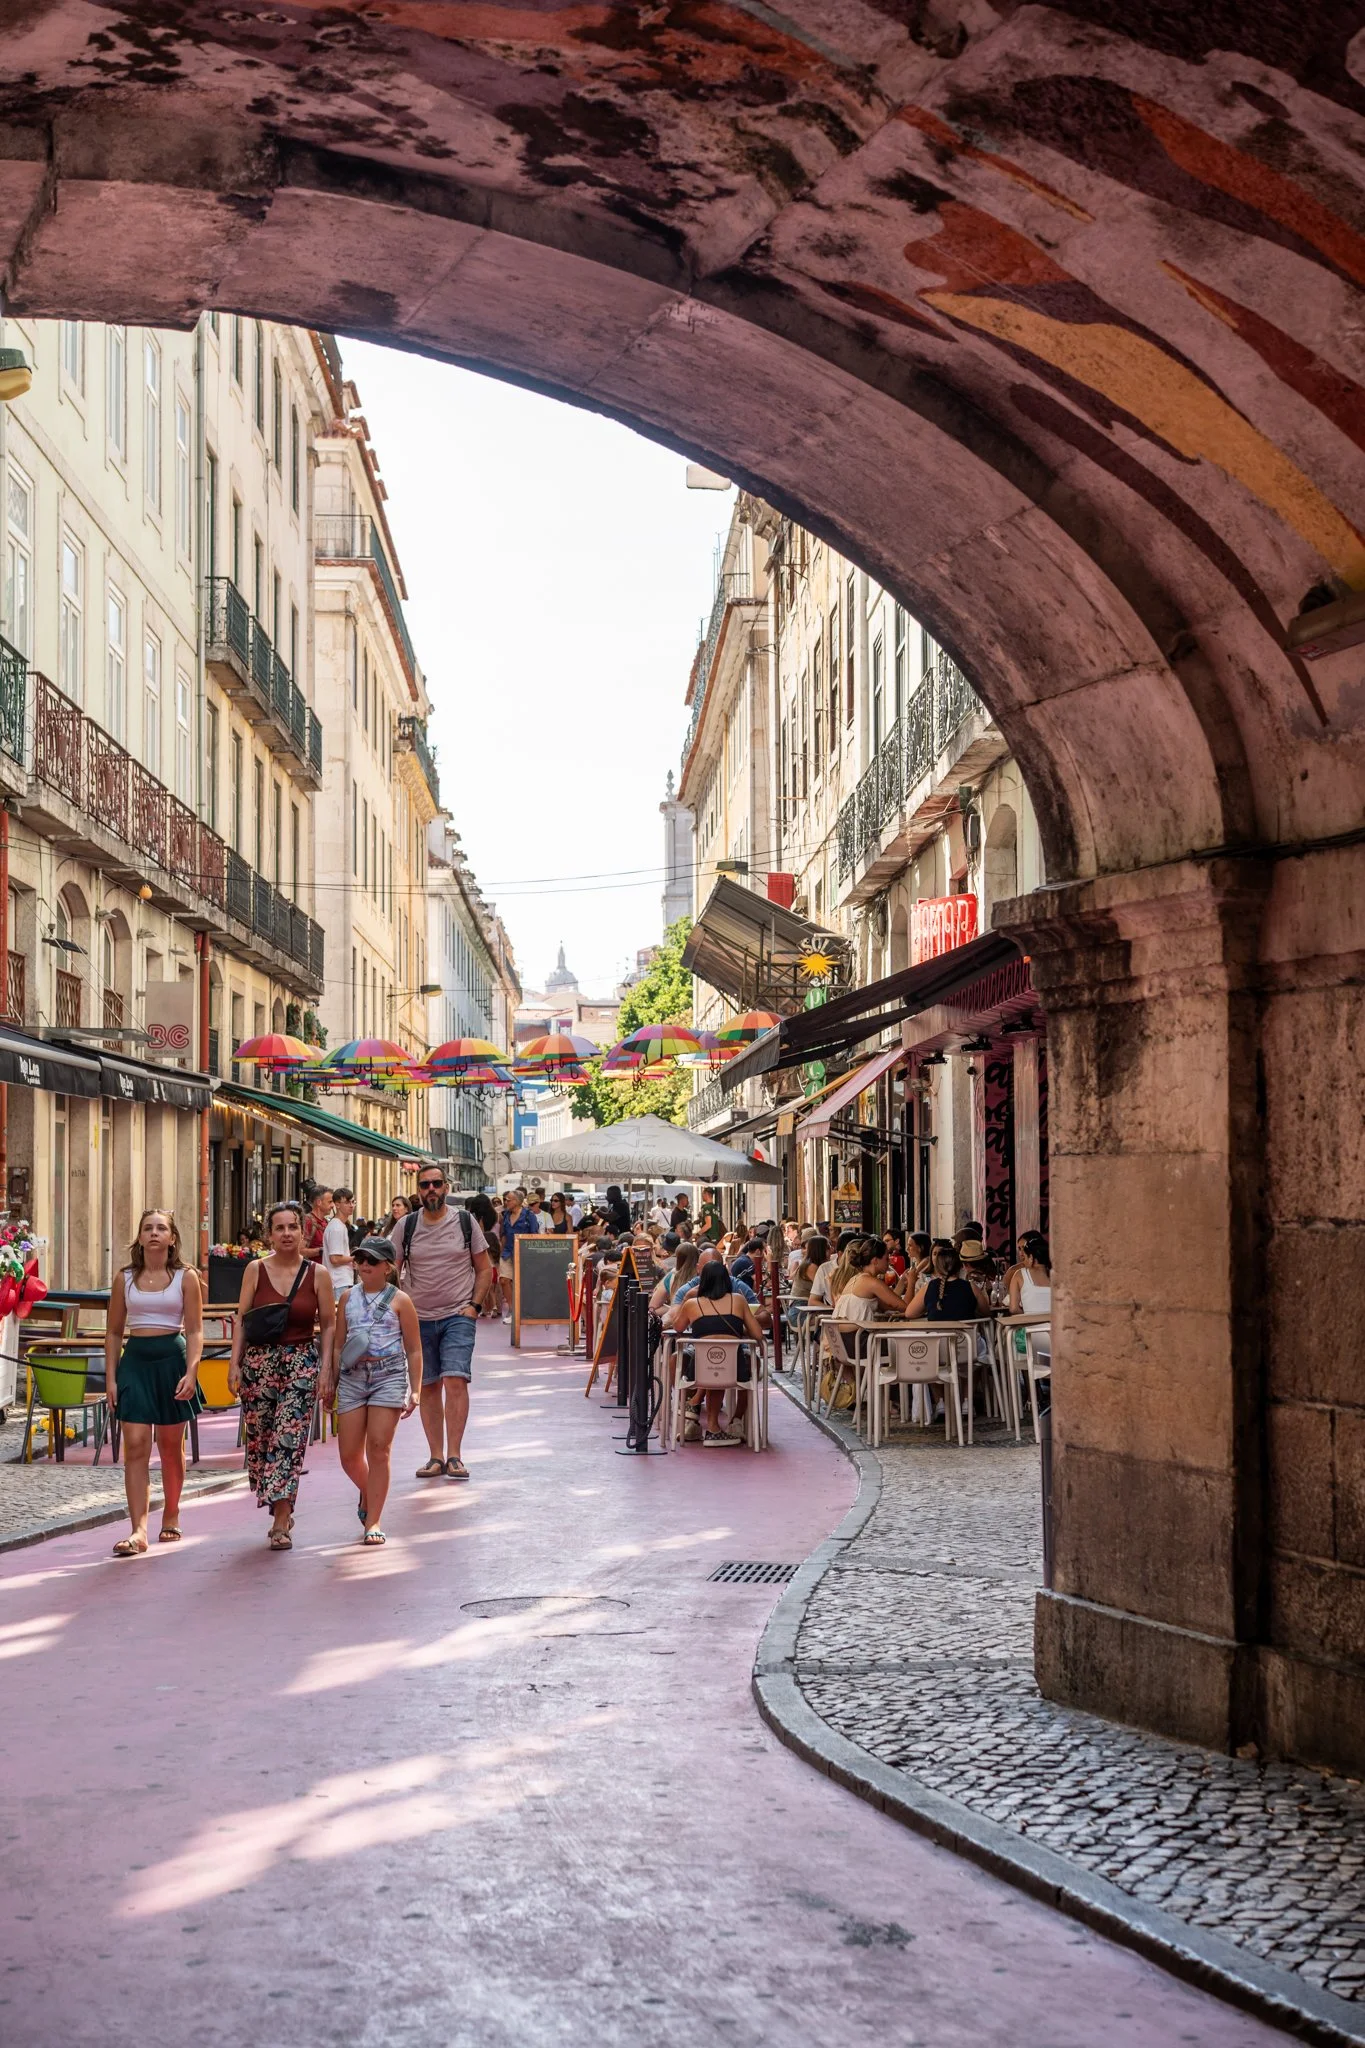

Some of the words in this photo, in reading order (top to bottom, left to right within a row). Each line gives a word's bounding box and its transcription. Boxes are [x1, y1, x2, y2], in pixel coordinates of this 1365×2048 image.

[801, 937, 830, 955] SOL
[148, 1024, 189, 1049] BC
[522, 1148, 696, 1175] Heineken
